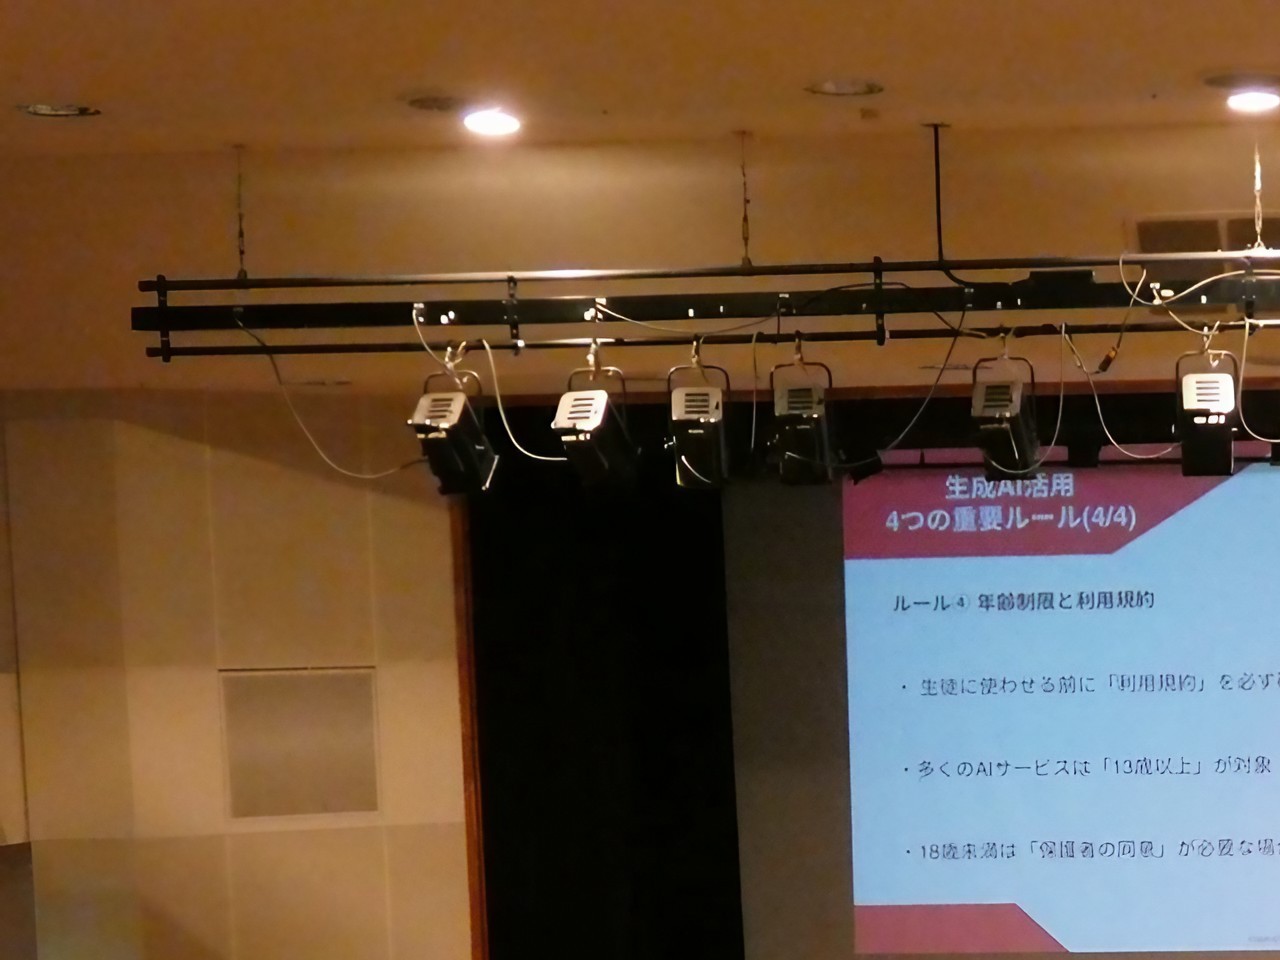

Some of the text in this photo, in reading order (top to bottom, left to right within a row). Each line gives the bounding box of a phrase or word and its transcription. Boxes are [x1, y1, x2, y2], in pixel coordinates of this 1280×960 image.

[945, 473, 1076, 499] 生成AI活用
[885, 505, 1137, 533] 4つの重要ルール(4/4)
